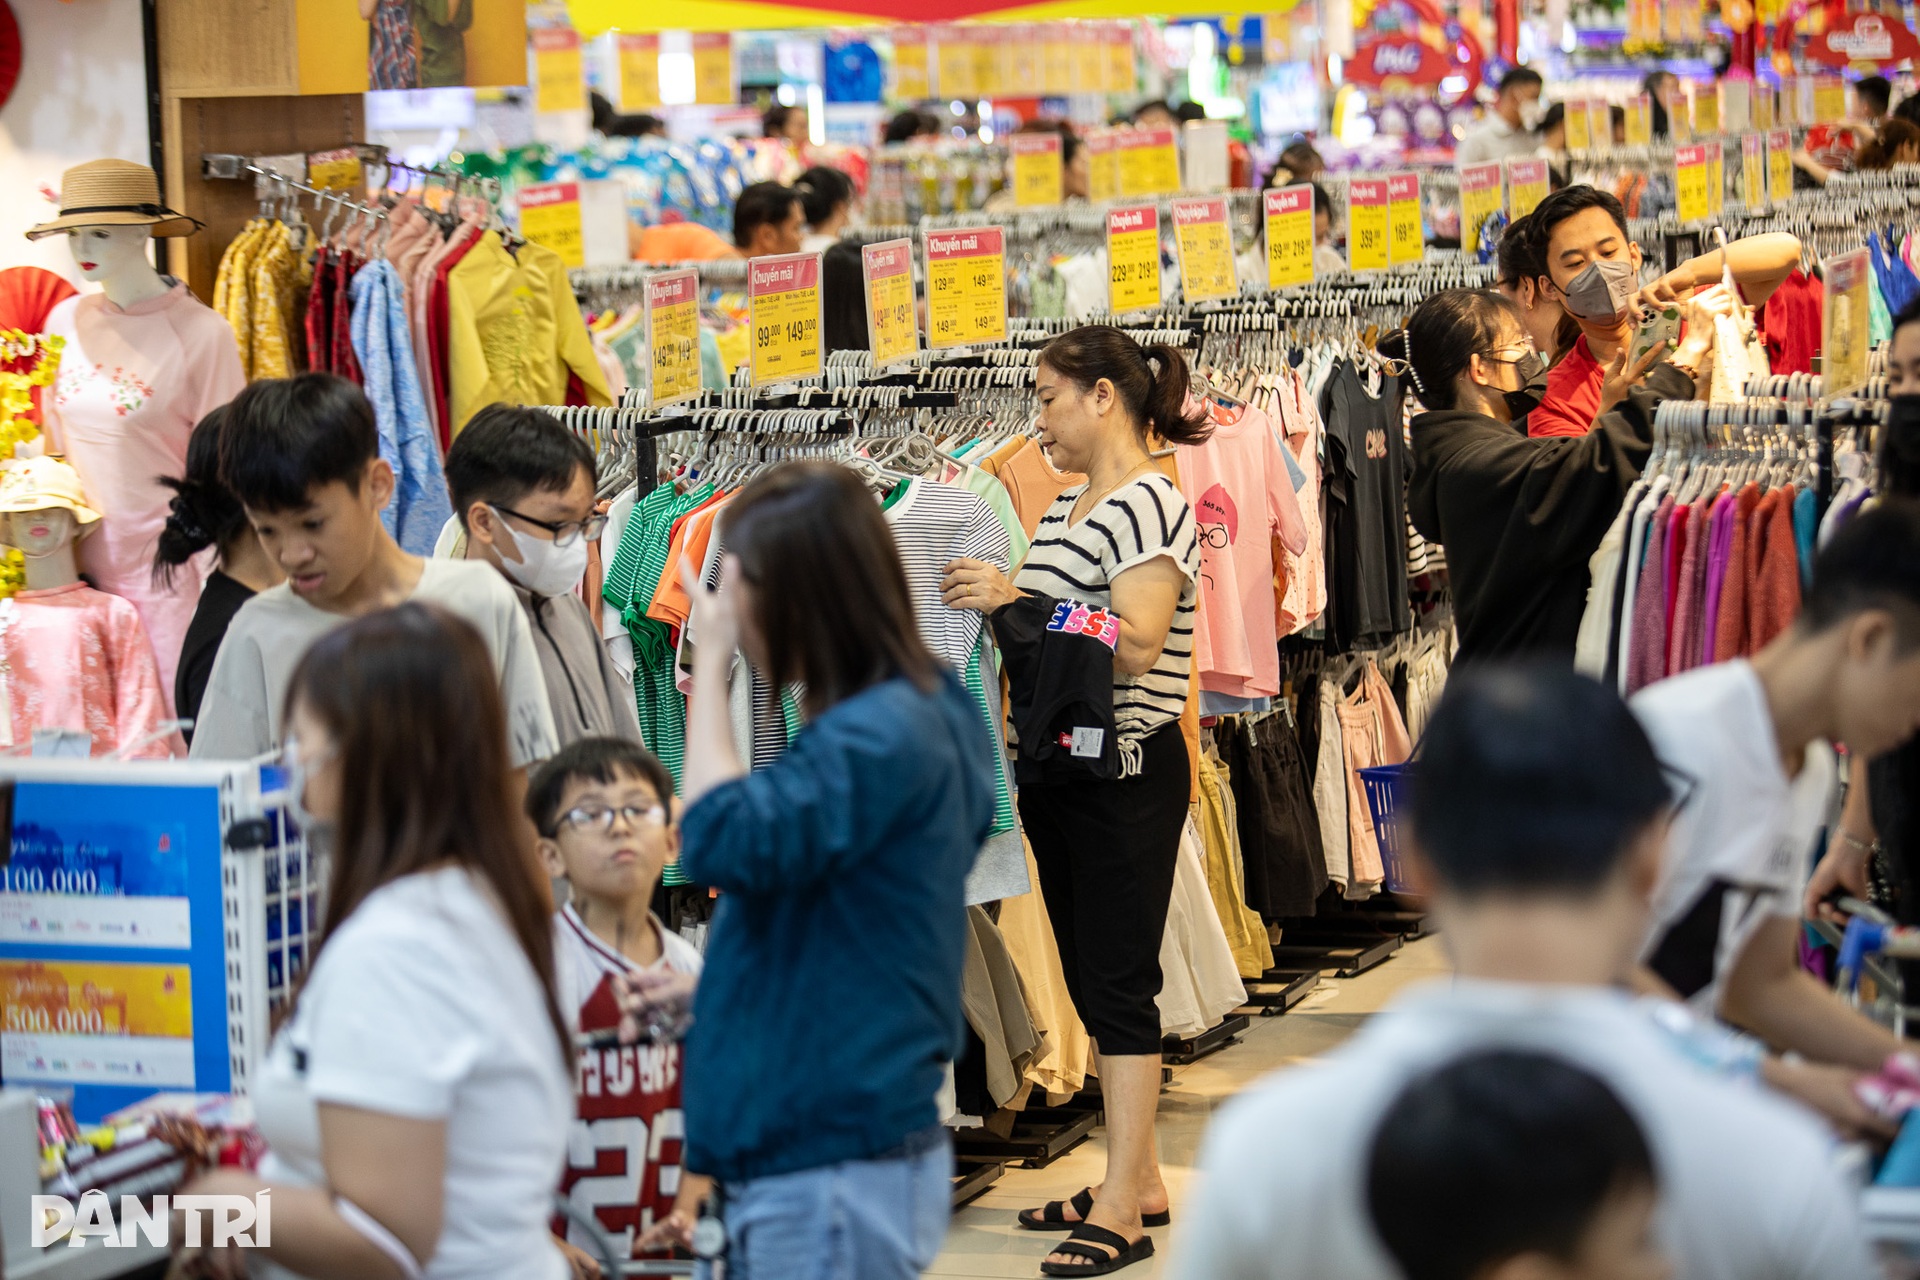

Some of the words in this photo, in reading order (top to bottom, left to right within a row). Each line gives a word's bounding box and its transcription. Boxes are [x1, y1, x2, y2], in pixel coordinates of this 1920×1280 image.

[1267, 193, 1287, 212] Khuyến
[1110, 210, 1132, 231] Khuyến
[930, 235, 961, 256] Khuyến
[961, 235, 978, 251] mãi
[754, 265, 779, 287] Khuyến
[780, 264, 794, 281] mãi
[651, 281, 673, 302] Khuyến
[673, 279, 683, 297] mãi
[1202, 500, 1215, 510] 365
